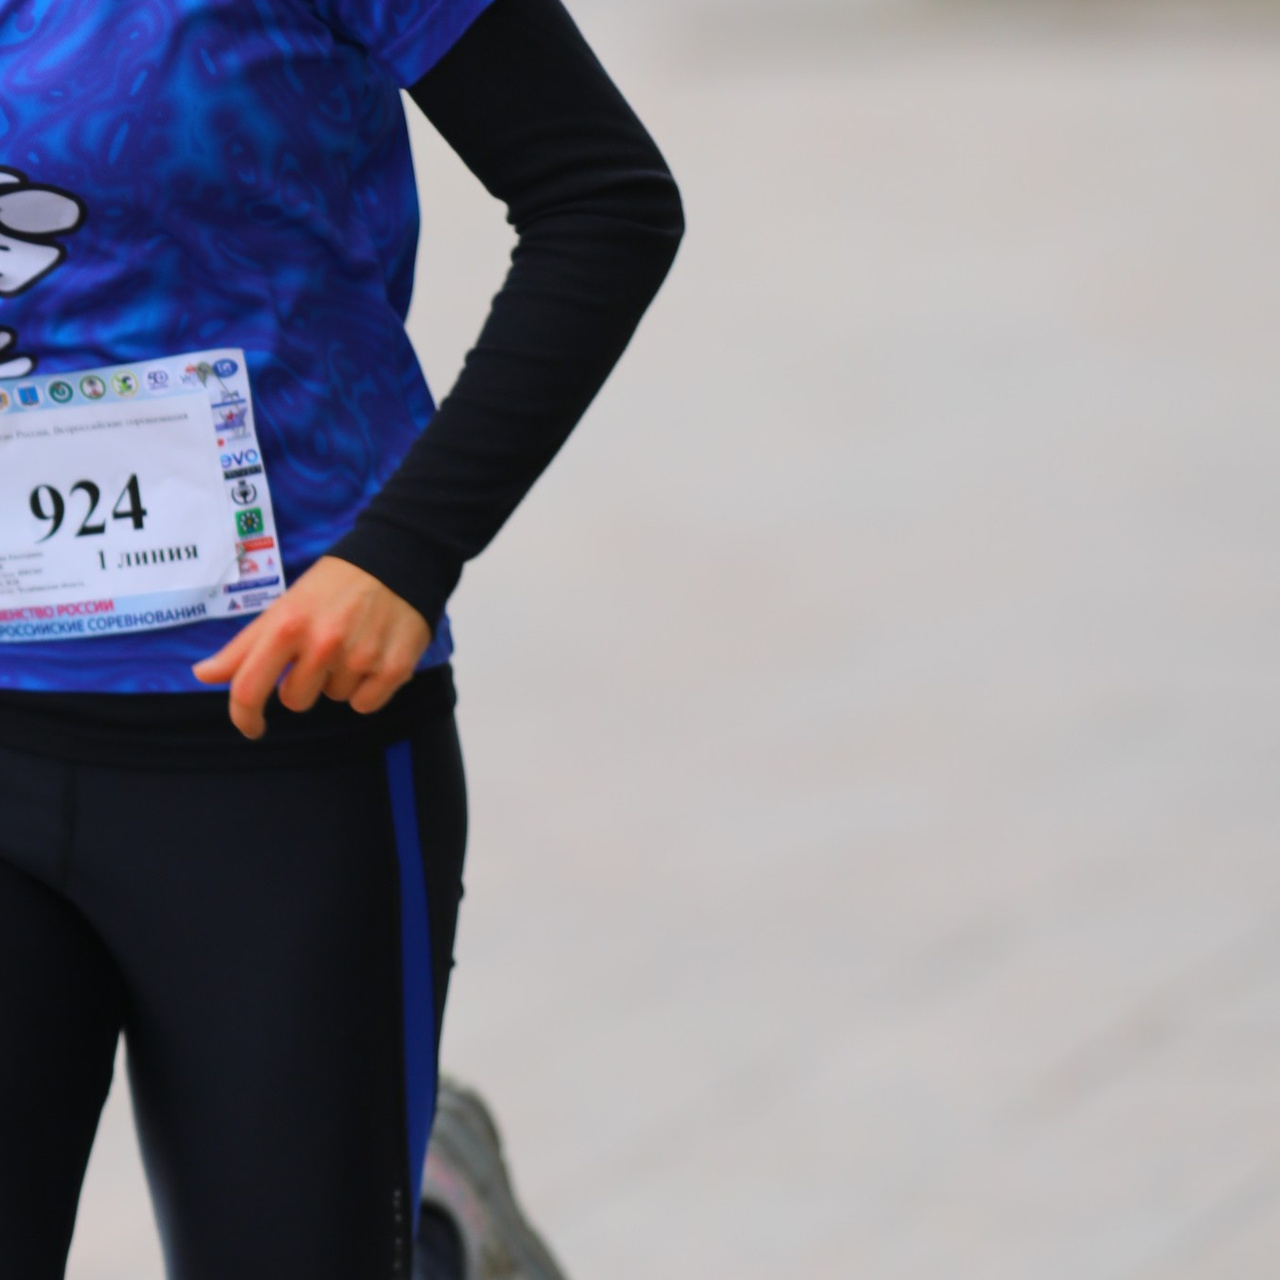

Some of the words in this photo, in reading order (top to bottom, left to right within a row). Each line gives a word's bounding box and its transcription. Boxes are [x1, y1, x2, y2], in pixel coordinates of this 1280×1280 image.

[29, 473, 148, 543] 924
[97, 550, 107, 570] 1
[118, 544, 199, 570] линия
[57, 598, 114, 617] РОССИИ
[87, 602, 207, 632] СОРЕВНОВАНИЯ
